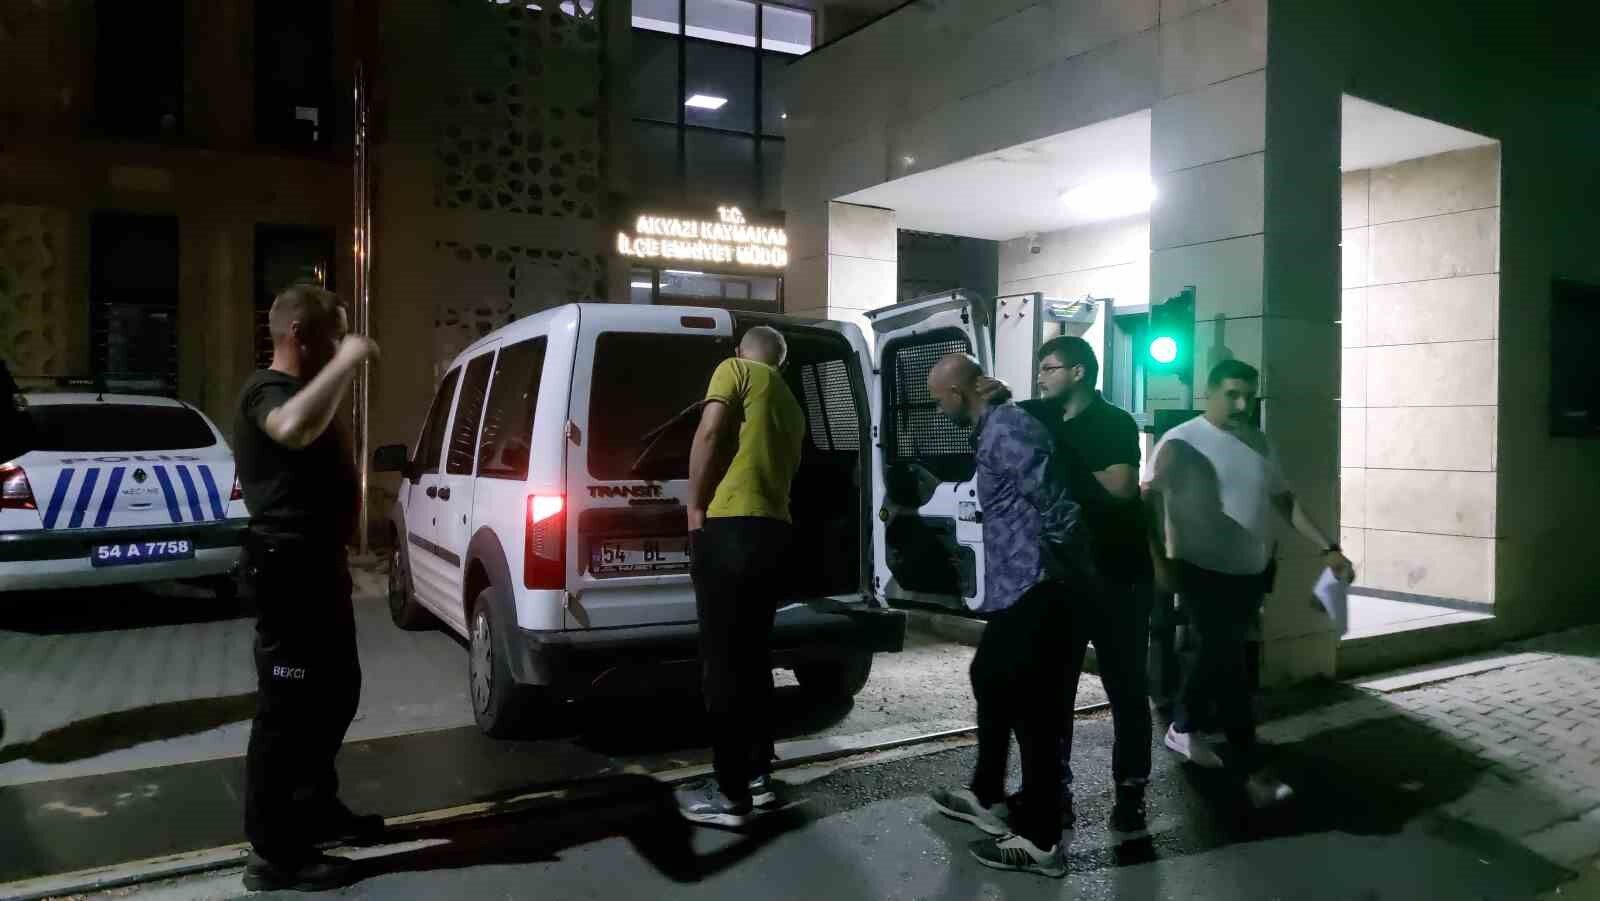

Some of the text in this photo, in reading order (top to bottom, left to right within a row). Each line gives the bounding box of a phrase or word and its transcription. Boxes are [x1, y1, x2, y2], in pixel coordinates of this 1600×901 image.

[587, 485, 663, 498] TRANSIT
[98, 540, 189, 559] 54 A 7758
[601, 542, 625, 562] 54
